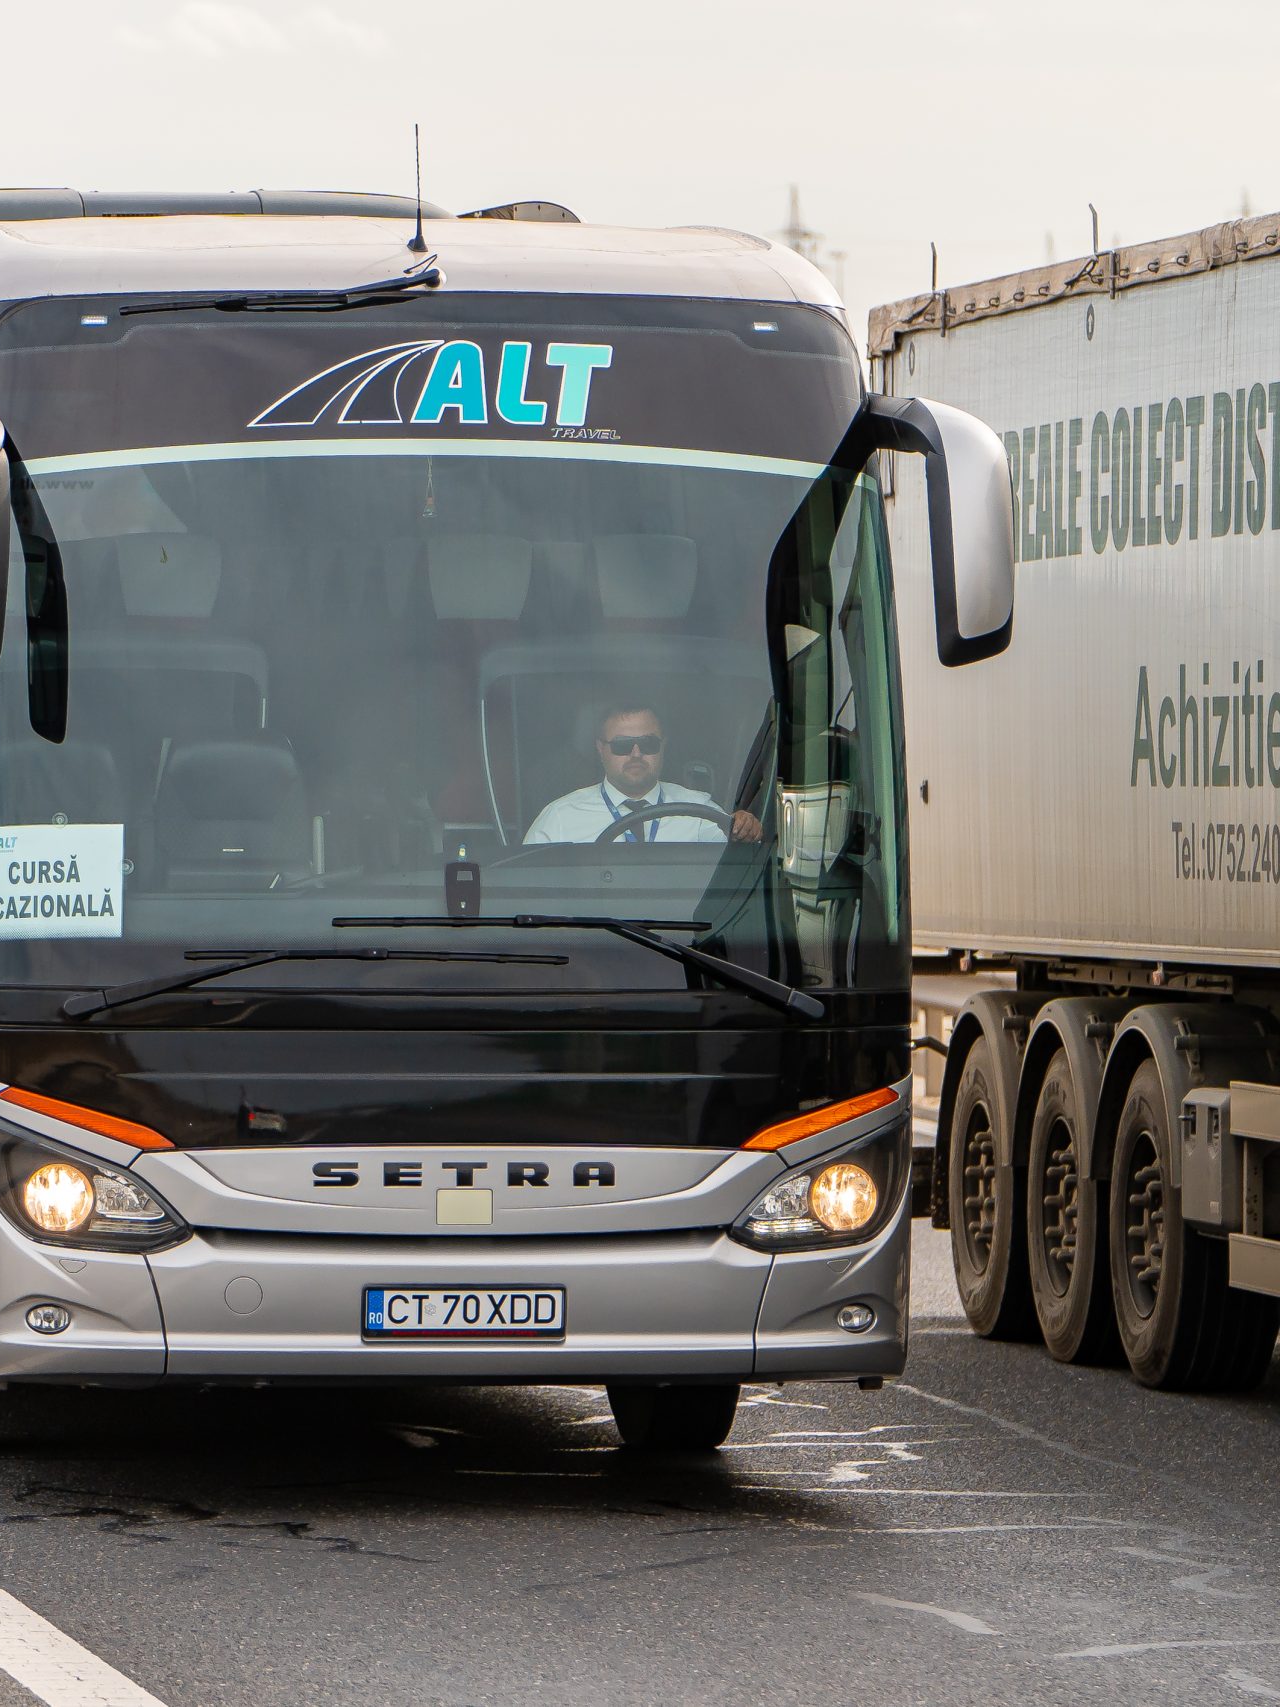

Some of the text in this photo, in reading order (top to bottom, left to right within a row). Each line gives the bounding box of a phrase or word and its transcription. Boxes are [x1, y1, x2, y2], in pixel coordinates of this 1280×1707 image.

[410, 339, 613, 426] ALT
[551, 427, 621, 440] TRAVEL
[998, 418, 1082, 563] REALE
[1090, 396, 1205, 555] COLECT
[8, 854, 81, 885] CURSĂ
[312, 1161, 615, 1187] SETRA
[369, 1294, 556, 1325] RO CT 70 XDD
